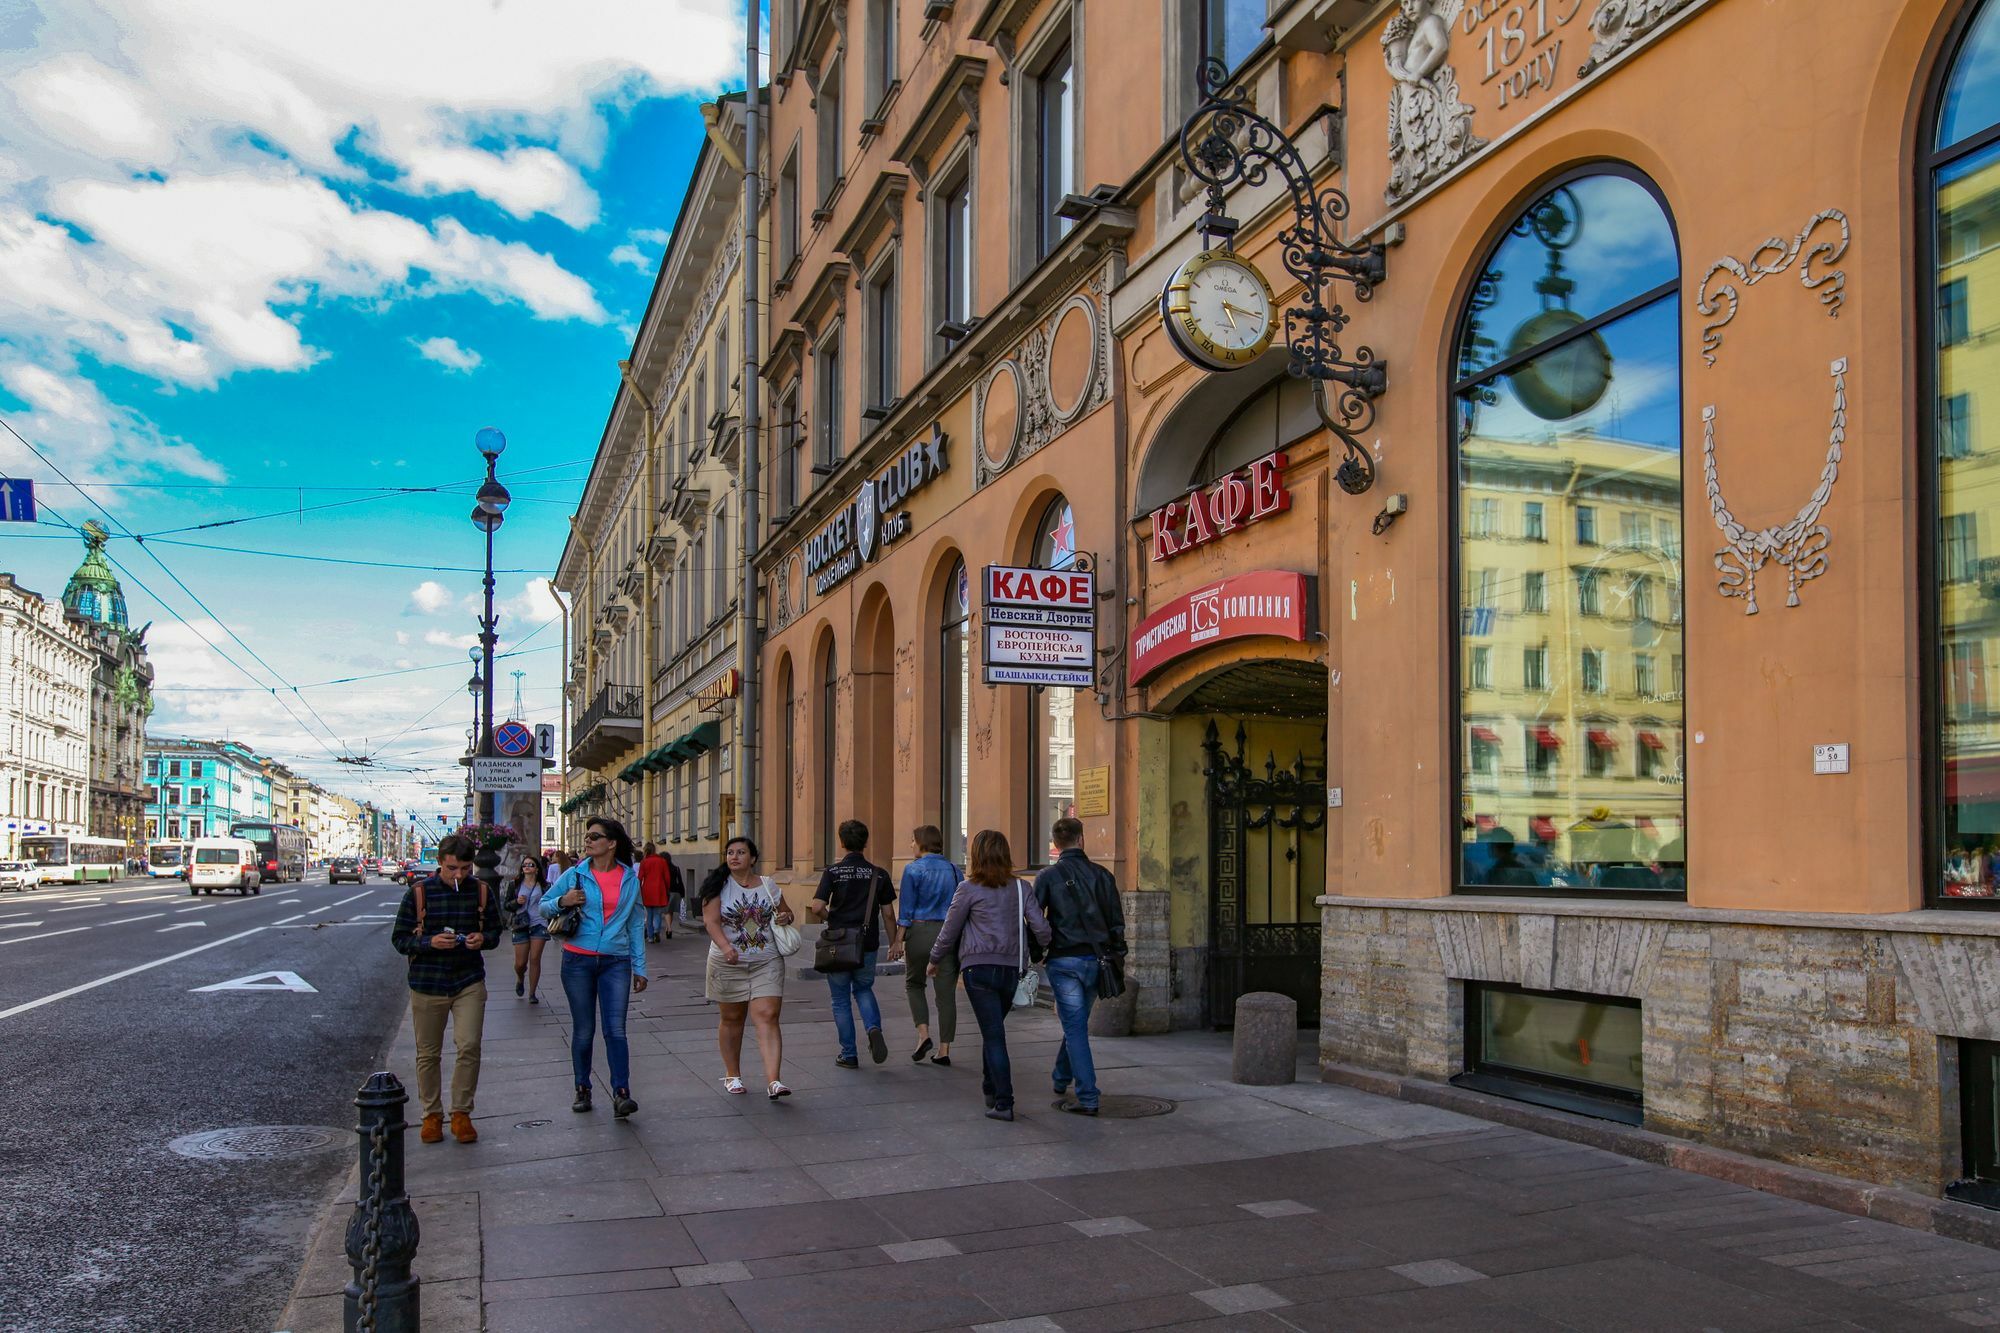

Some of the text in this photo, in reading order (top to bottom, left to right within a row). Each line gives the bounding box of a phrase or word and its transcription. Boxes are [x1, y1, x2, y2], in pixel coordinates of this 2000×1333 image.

[1498, 40, 1562, 110] году
[1213, 284, 1238, 295] OMEGA
[878, 441, 924, 514] CLUB
[1149, 453, 1286, 562] КАФЕ
[805, 503, 853, 578] HOCKEY
[881, 511, 907, 546] КЛУБ
[992, 571, 1089, 604] КАФЕ
[991, 608, 1092, 626] Невский Дворик
[1135, 612, 1187, 660] ТУРИСТИЧЕСКАЯ
[1190, 596, 1220, 632] ICS
[1223, 596, 1290, 619] КОМПАНИЯ
[996, 640, 1083, 653] ЕВРОПЕЙСКАЯ
[1004, 630, 1073, 642] ВОСТОЧНО-
[1019, 652, 1059, 662] КУХНЯ
